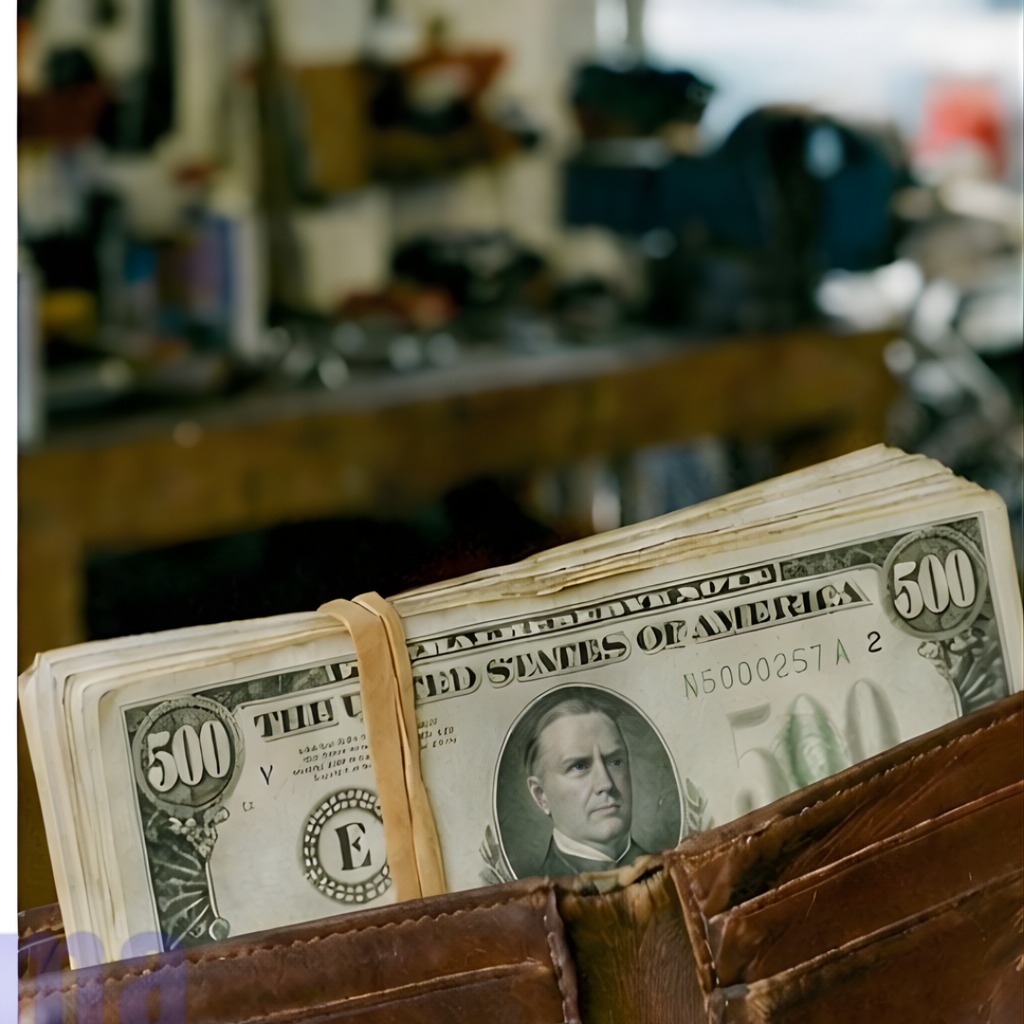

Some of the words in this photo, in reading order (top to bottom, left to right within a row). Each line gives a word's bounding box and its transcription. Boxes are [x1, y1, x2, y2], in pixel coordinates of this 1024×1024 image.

[893, 549, 976, 620] 500
[867, 630, 883, 653] 2
[147, 719, 233, 793] 500
[335, 821, 373, 872] E
